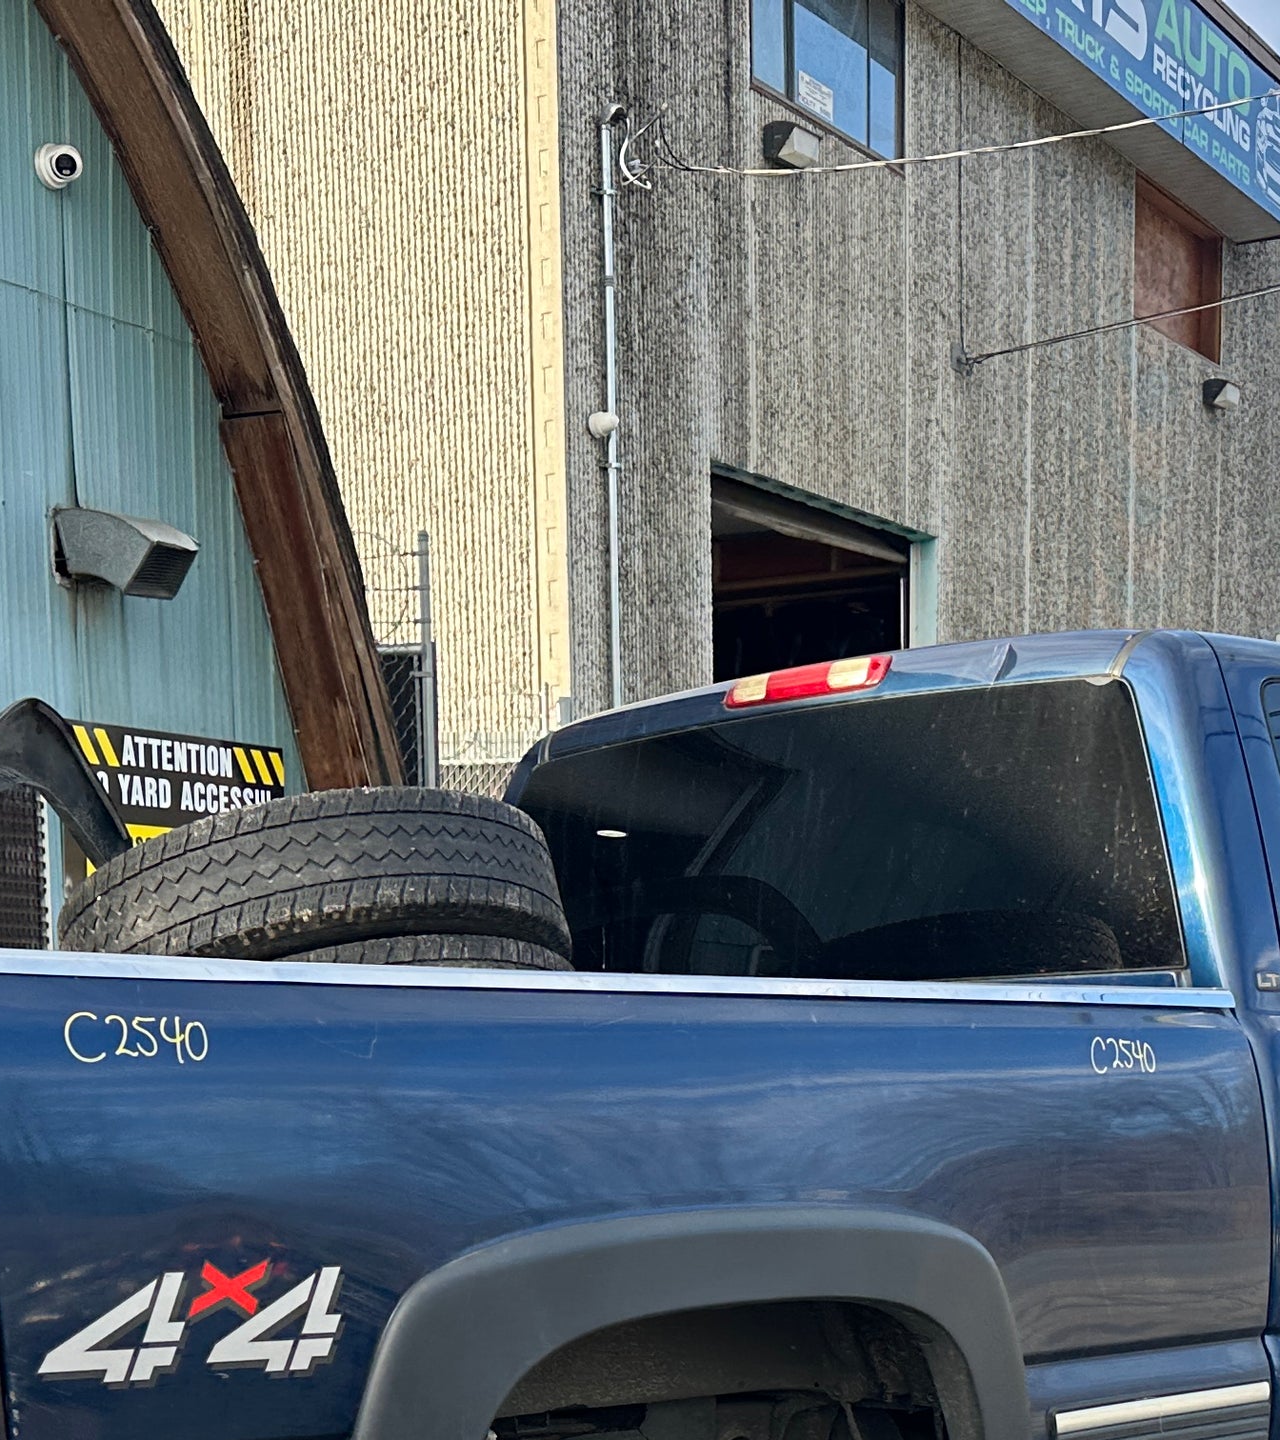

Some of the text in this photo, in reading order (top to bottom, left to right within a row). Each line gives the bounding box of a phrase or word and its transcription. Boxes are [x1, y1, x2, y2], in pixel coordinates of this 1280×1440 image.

[1155, 0, 1250, 116] AUTO
[1055, 7, 1105, 69] TRUCK
[1110, 54, 1120, 81] &
[1125, 70, 1177, 127] SPORTS
[1184, 118, 1208, 154] CAR
[1212, 140, 1250, 185] PARTS
[1153, 44, 1250, 152] RECYCLING
[122, 734, 233, 779] ATTENTION
[117, 773, 172, 809] YARD
[1256, 972, 1280, 988] LT
[63, 1010, 209, 1064] C2540
[1090, 1036, 1156, 1074] C2540
